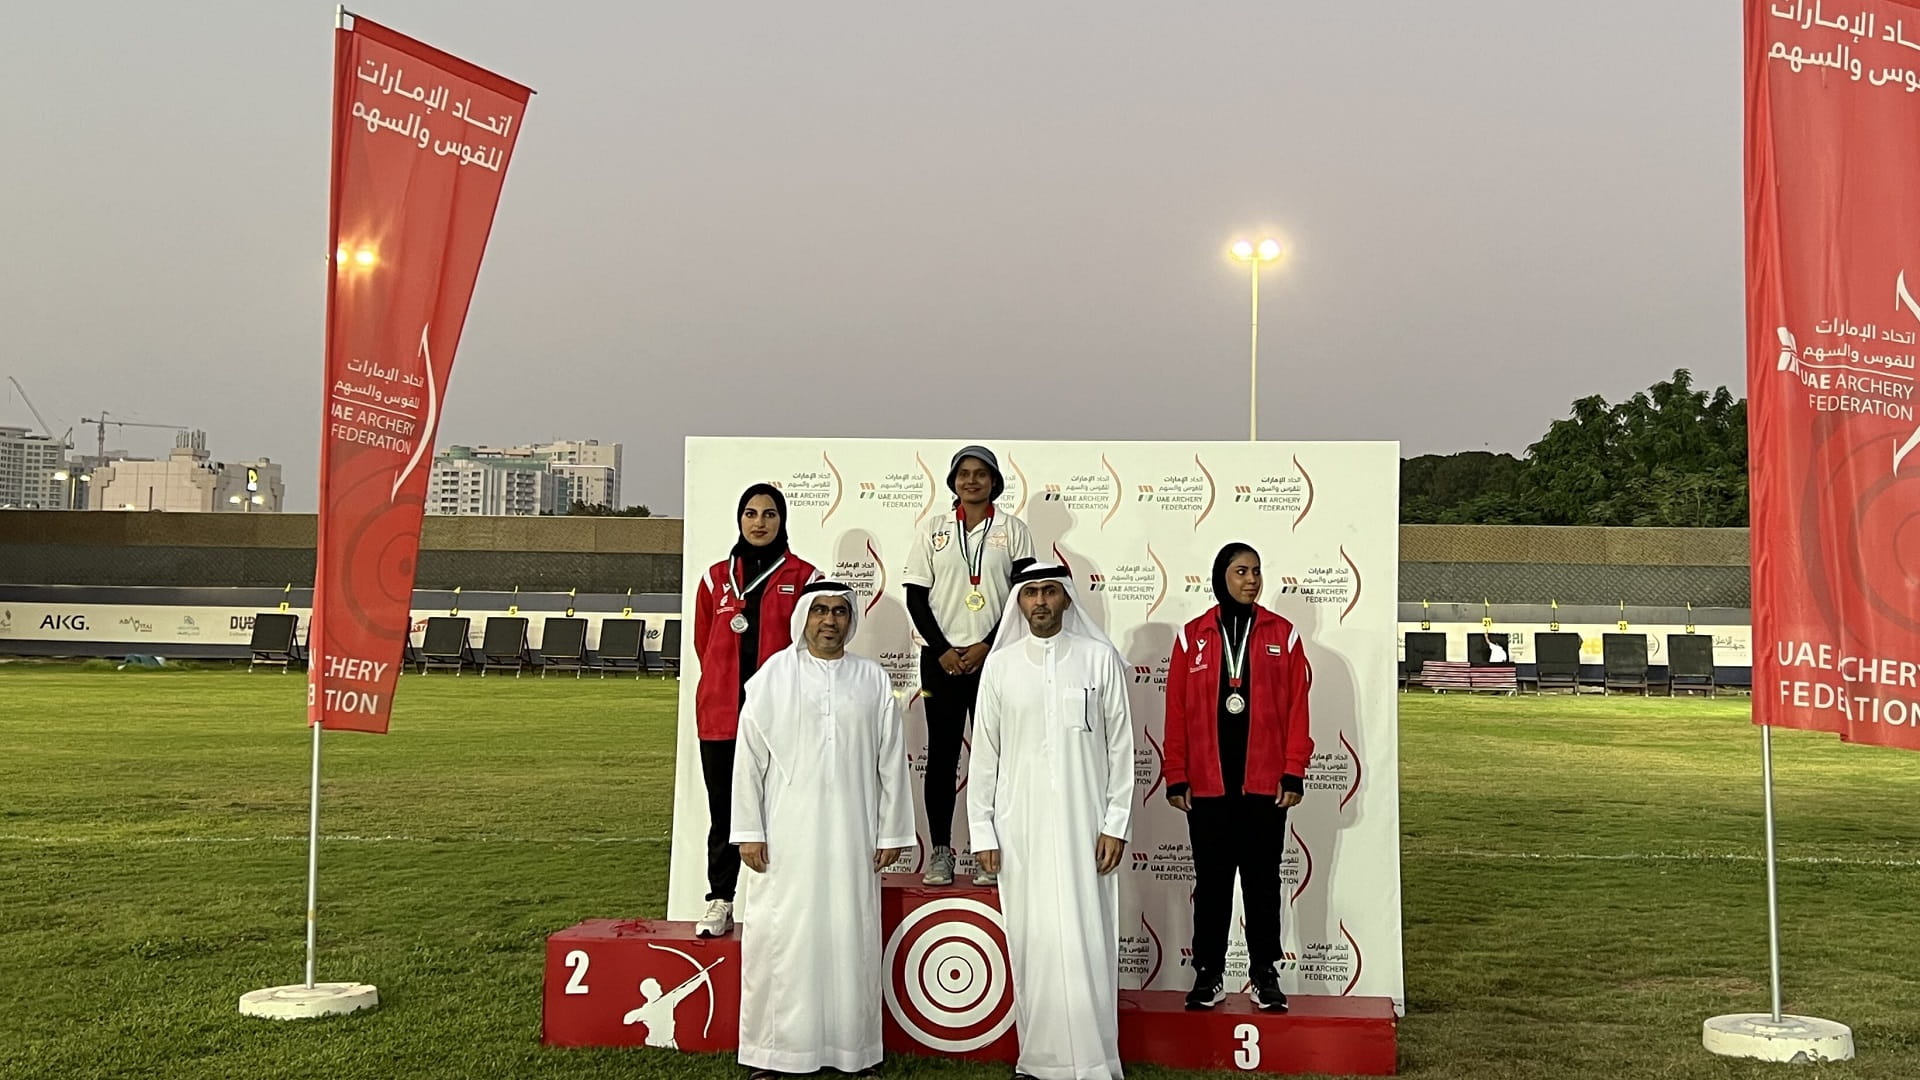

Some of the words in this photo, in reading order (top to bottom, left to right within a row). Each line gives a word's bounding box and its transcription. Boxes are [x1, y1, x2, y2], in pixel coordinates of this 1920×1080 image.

[352, 101, 430, 148] والسهم
[452, 98, 513, 138] اتحاد
[434, 138, 504, 172] للقوس
[1882, 329, 1916, 345] اتحاد
[1803, 343, 1859, 362] والسهم
[1863, 355, 1915, 369] للقوس
[1800, 369, 1831, 389] UAE
[1835, 373, 1914, 400] ARCHERY
[1809, 394, 1913, 421] FEDERATION
[356, 410, 415, 436] ARCHERY
[331, 423, 412, 455] FEDERATION
[40, 614, 90, 631] AKG.
[1778, 641, 1833, 670] UAE
[1304, 782, 1348, 790] FEDERATION
[1316, 774, 1348, 782] ARCHERY
[1166, 865, 1194, 873] ARCHER
[565, 950, 590, 995] 2
[1299, 964, 1314, 972] UAE
[1315, 964, 1348, 973] ARCHERY
[1304, 973, 1349, 981] FEDERATION
[1234, 1023, 1260, 1070] 3
